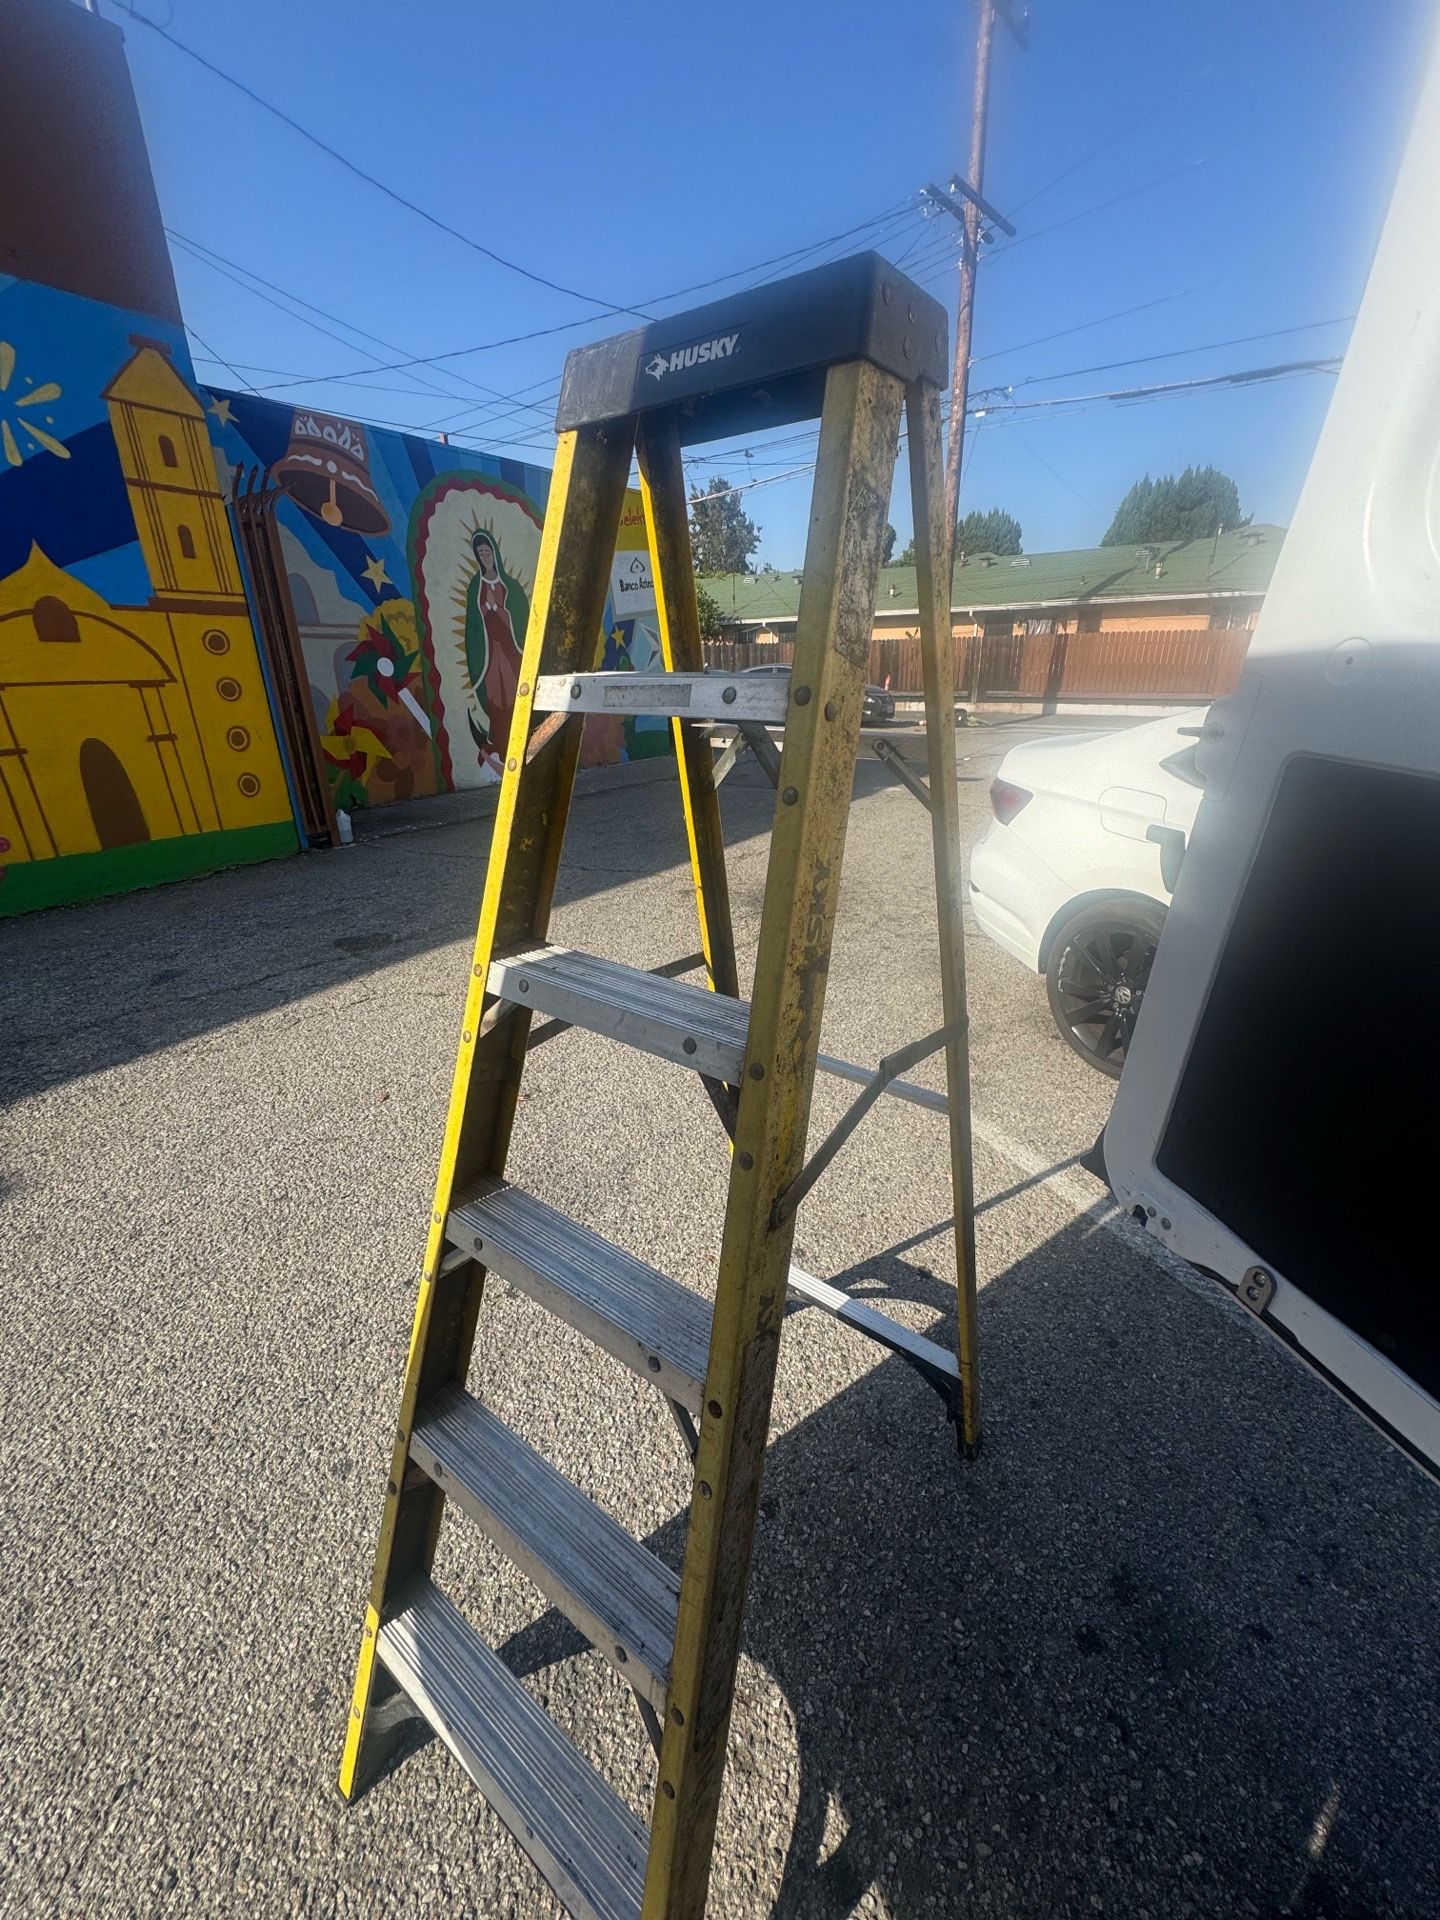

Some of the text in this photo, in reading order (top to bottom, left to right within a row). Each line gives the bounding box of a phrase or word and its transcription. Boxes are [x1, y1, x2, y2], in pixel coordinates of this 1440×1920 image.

[669, 333, 740, 372] HUSKY
[619, 577, 655, 592] Banco Aztec
